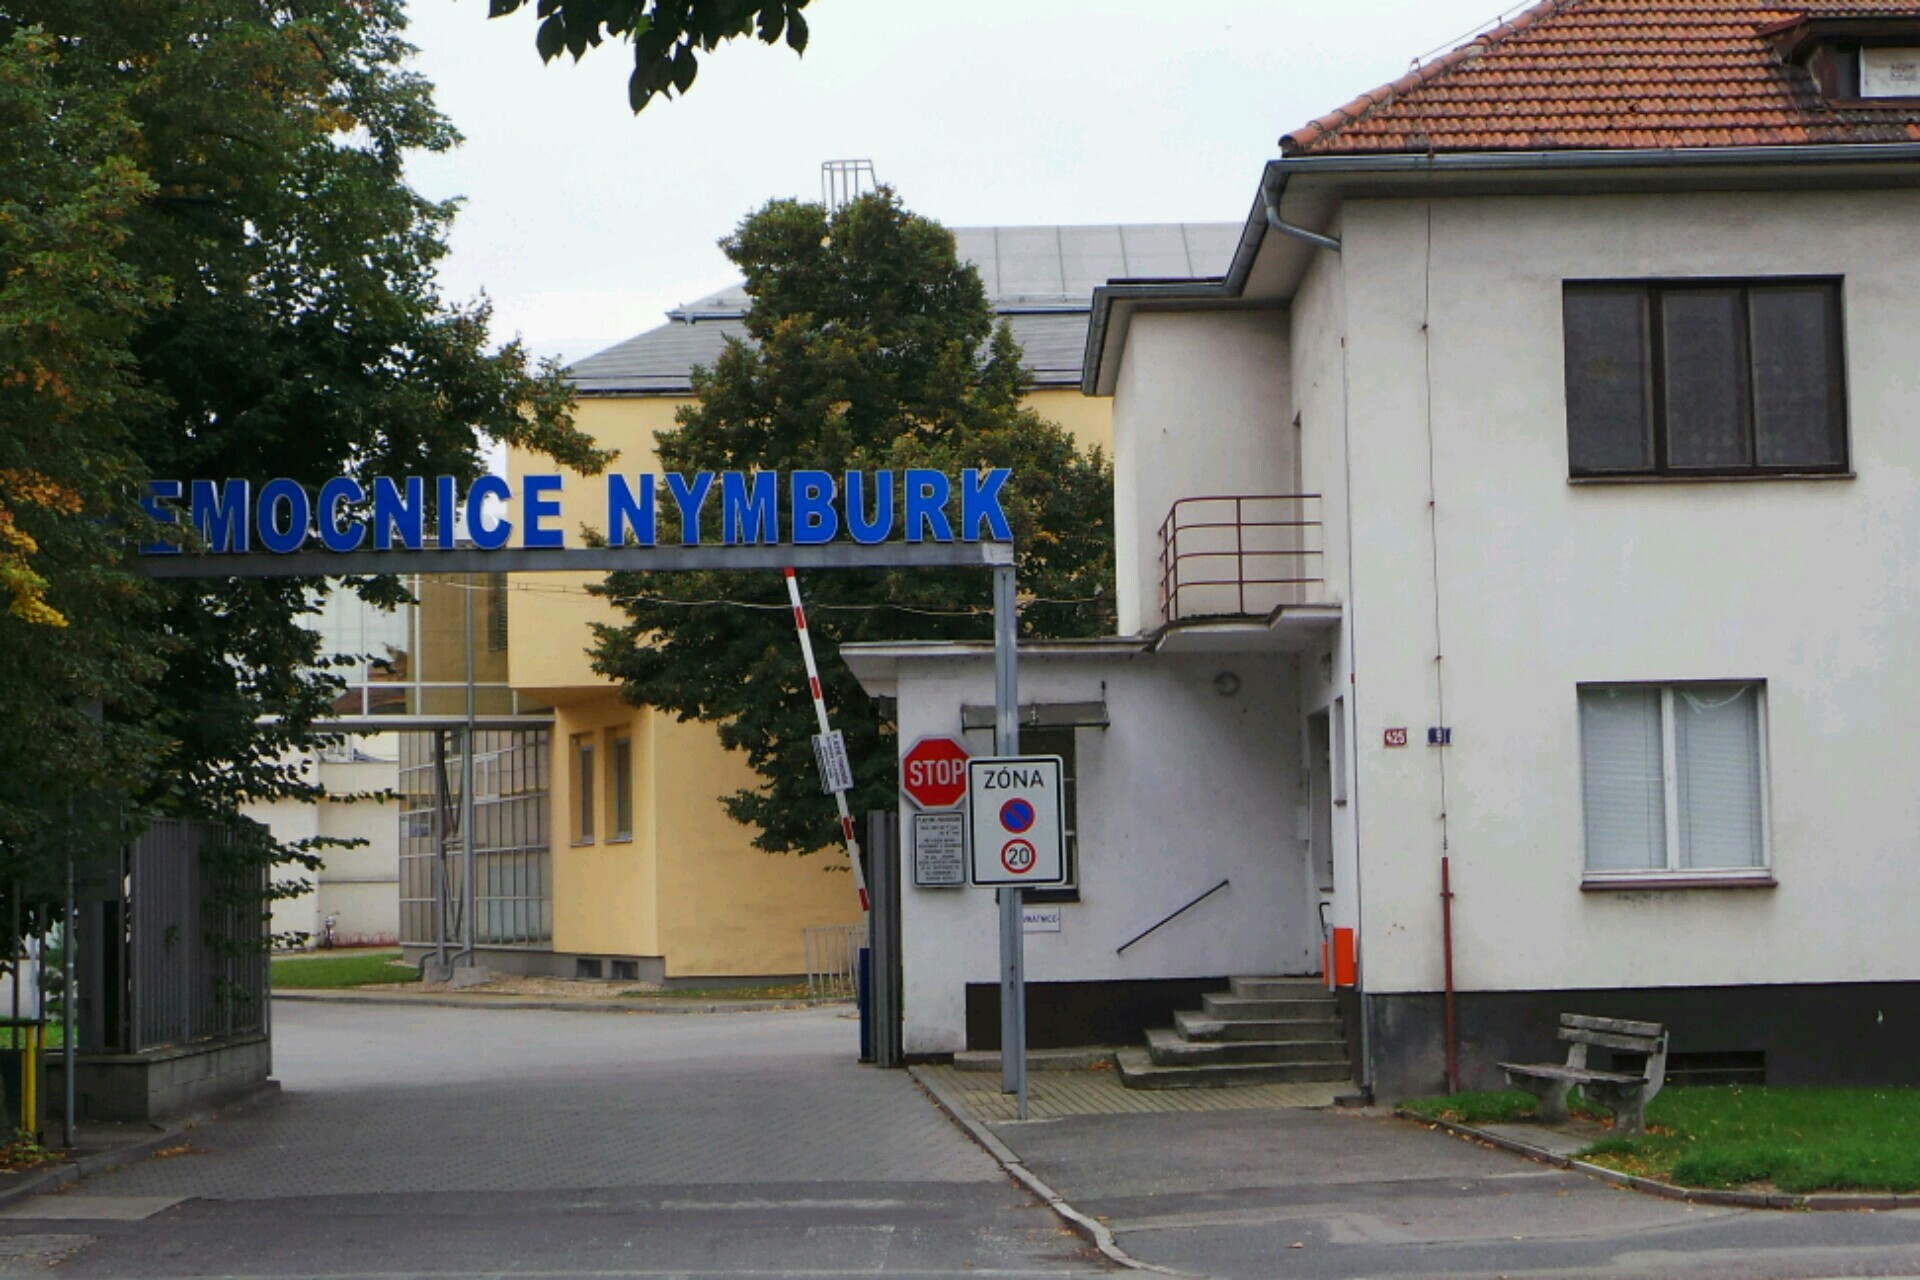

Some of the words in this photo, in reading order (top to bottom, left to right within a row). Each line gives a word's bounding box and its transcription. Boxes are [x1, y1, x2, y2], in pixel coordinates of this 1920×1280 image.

[96, 475, 564, 555] EMOCNICE
[608, 468, 1013, 547] NYMBURK
[909, 758, 965, 787] STOP
[983, 767, 1045, 789] ZÓNA
[1008, 847, 1030, 866] 20
